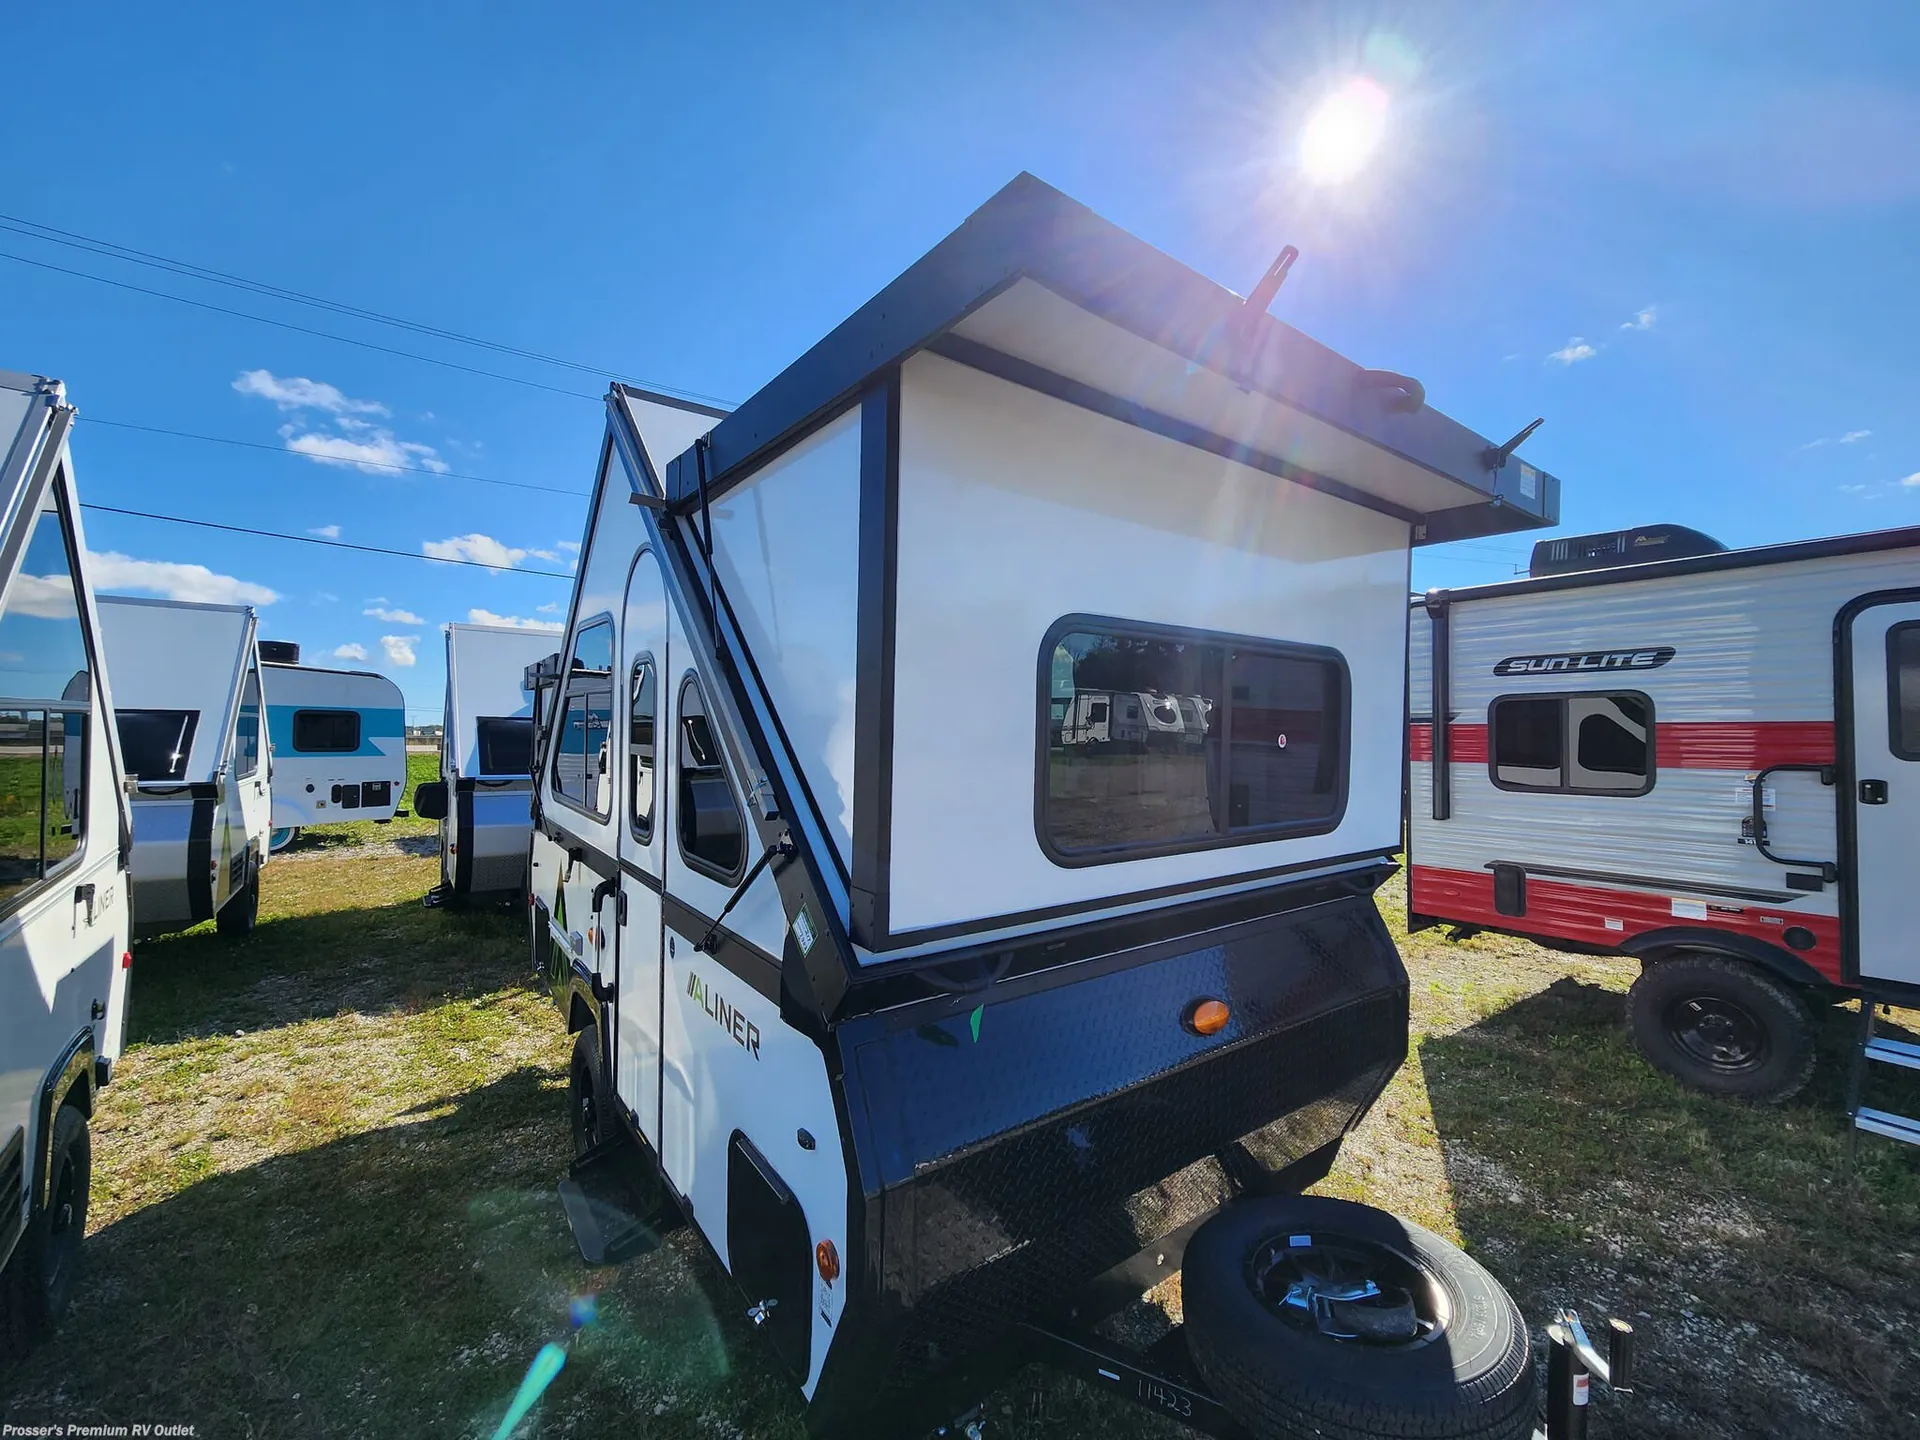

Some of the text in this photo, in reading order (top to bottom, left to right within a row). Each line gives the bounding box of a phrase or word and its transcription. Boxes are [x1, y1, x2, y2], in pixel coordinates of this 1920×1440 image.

[1577, 652, 1658, 668] LITE
[688, 971, 760, 1061] ALINER
[1138, 1379, 1192, 1417] 11423
